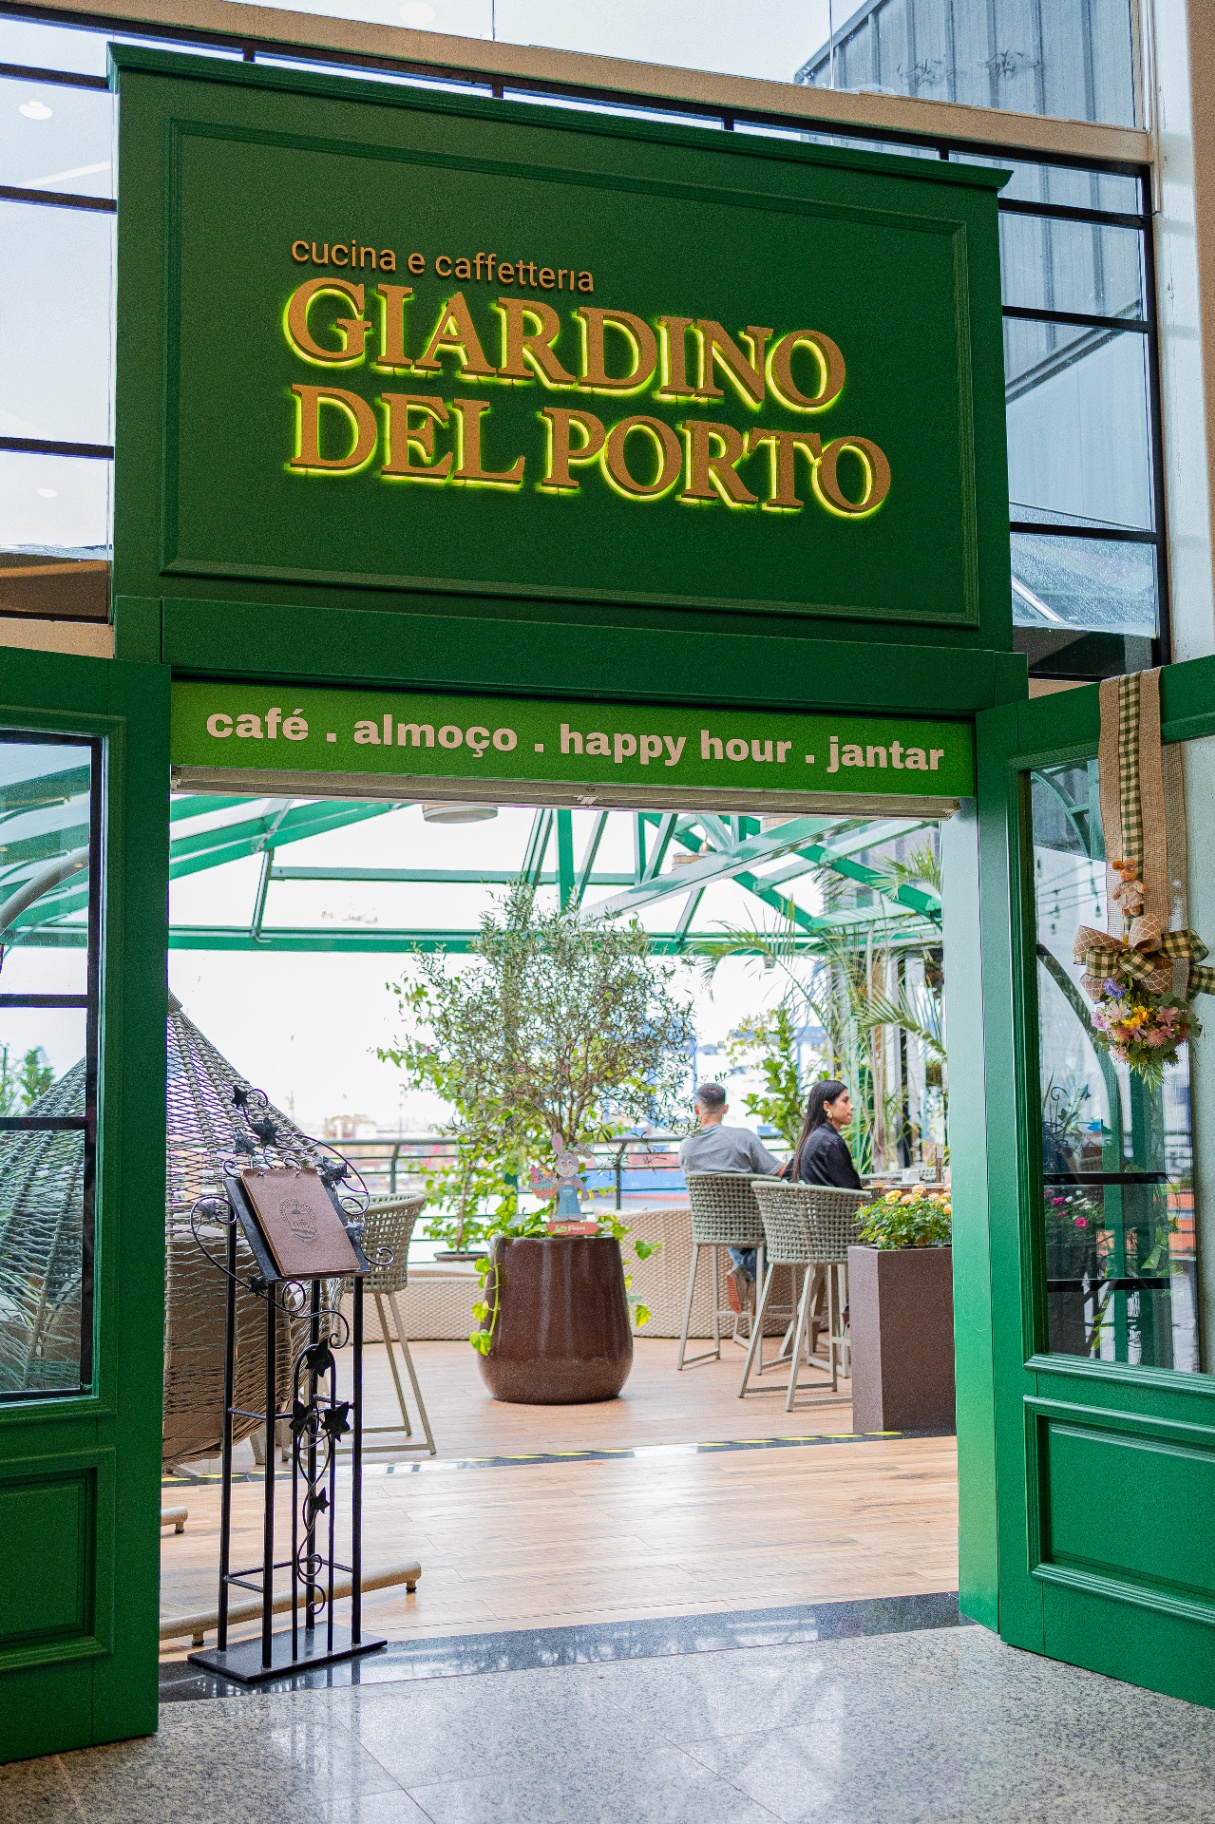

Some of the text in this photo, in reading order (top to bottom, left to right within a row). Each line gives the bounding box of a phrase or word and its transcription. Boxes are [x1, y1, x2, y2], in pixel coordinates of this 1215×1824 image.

[292, 239, 595, 293] cucina e caffetteria
[284, 276, 847, 411] GIARDINO
[288, 383, 892, 515] DEL PORTO
[206, 708, 310, 742] café
[353, 720, 518, 758] almoço
[560, 723, 687, 767] happy
[700, 729, 793, 765] hour
[826, 735, 945, 773] jantar
